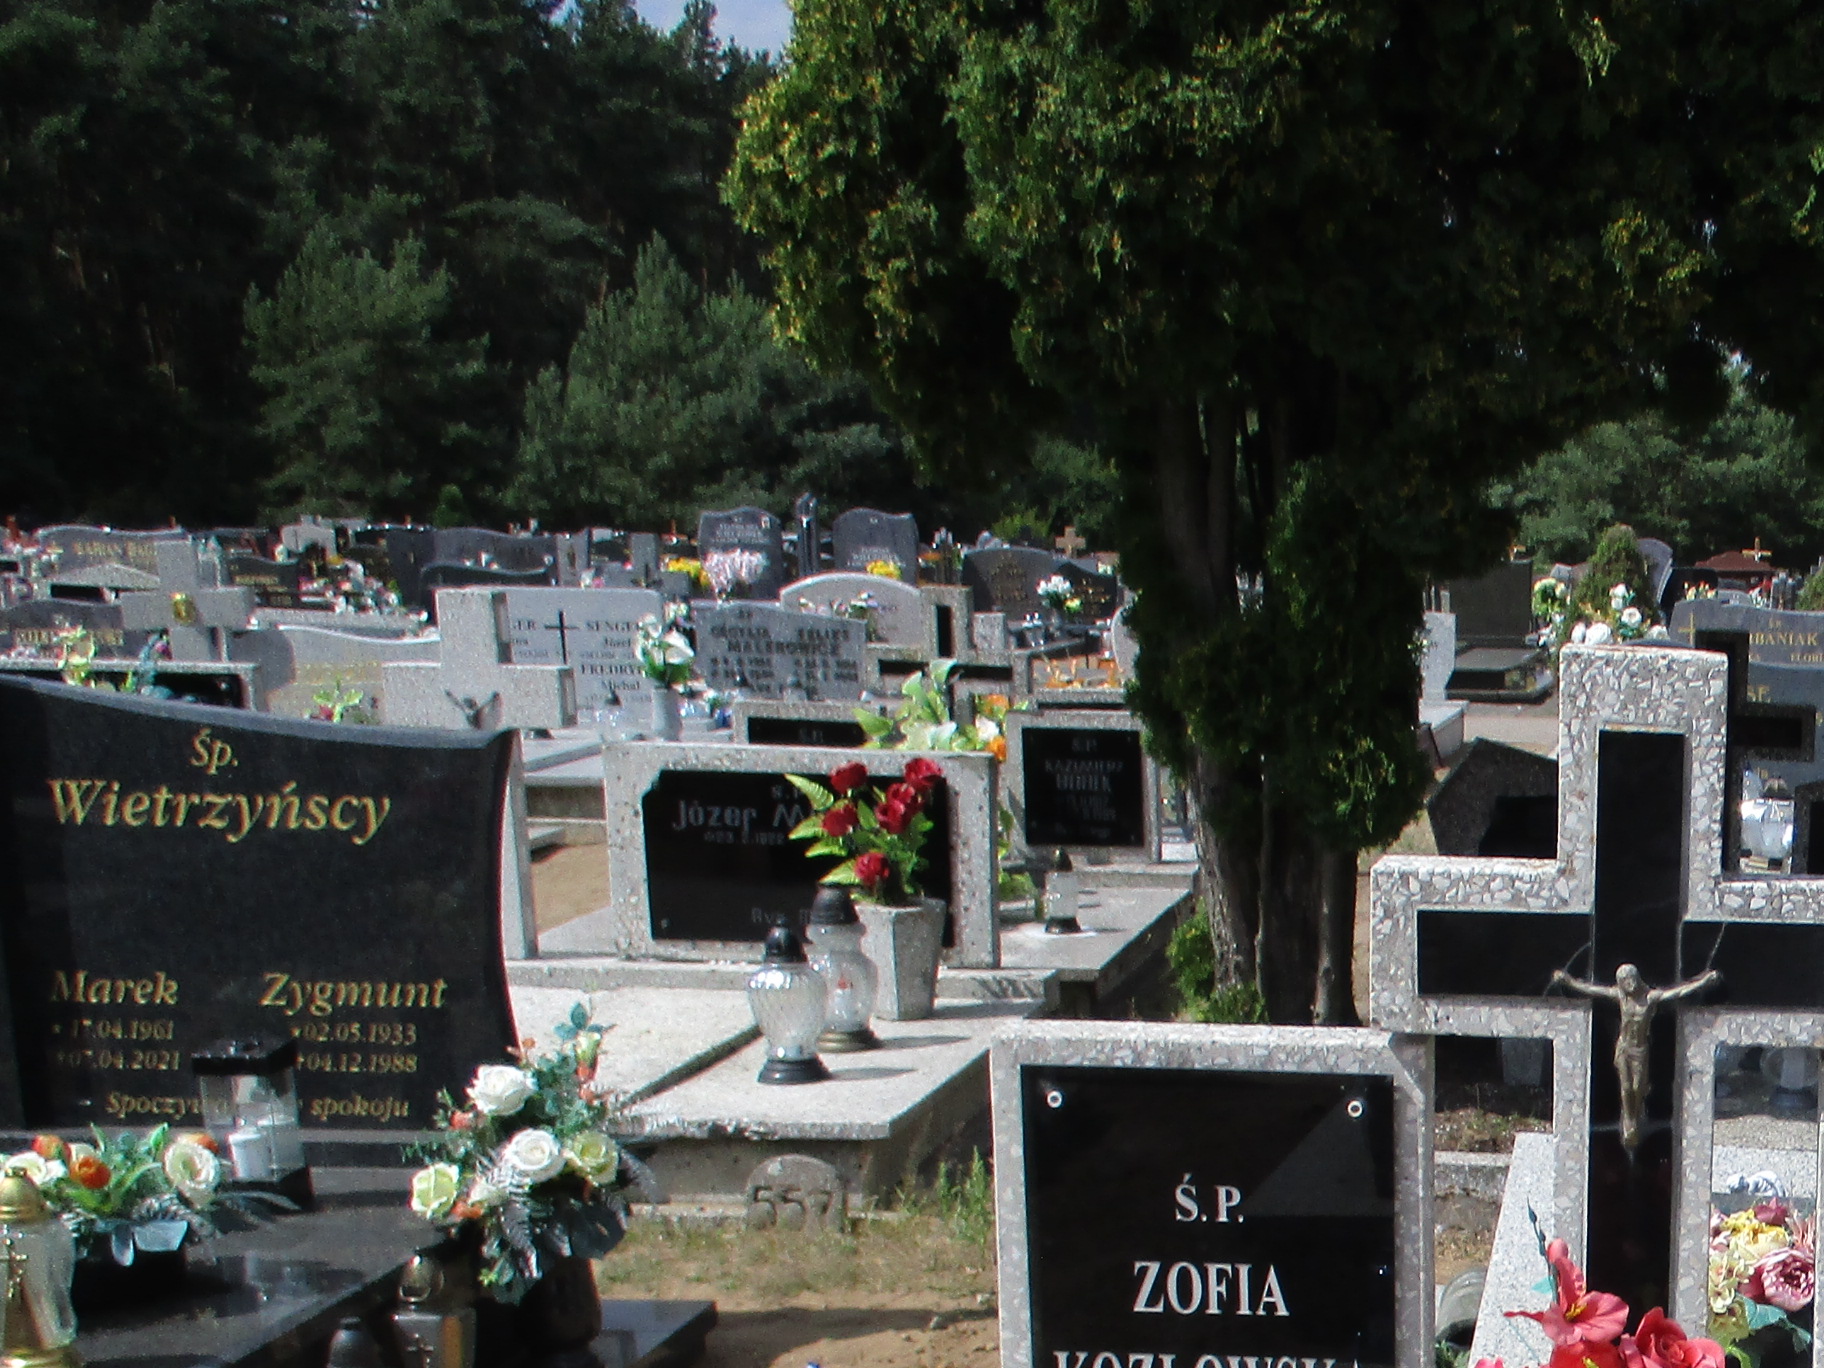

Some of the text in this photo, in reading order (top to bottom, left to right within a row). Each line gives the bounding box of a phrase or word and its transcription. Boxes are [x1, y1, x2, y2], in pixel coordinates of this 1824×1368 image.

[586, 621, 642, 632] SENGE
[46, 779, 391, 846] Wietrzyńscy
[52, 969, 179, 1006] Marek
[259, 971, 448, 1017] Zygmunt
[1175, 1173, 1246, 1223] Ś.P.
[1132, 1260, 1291, 1318] ZOFIA
